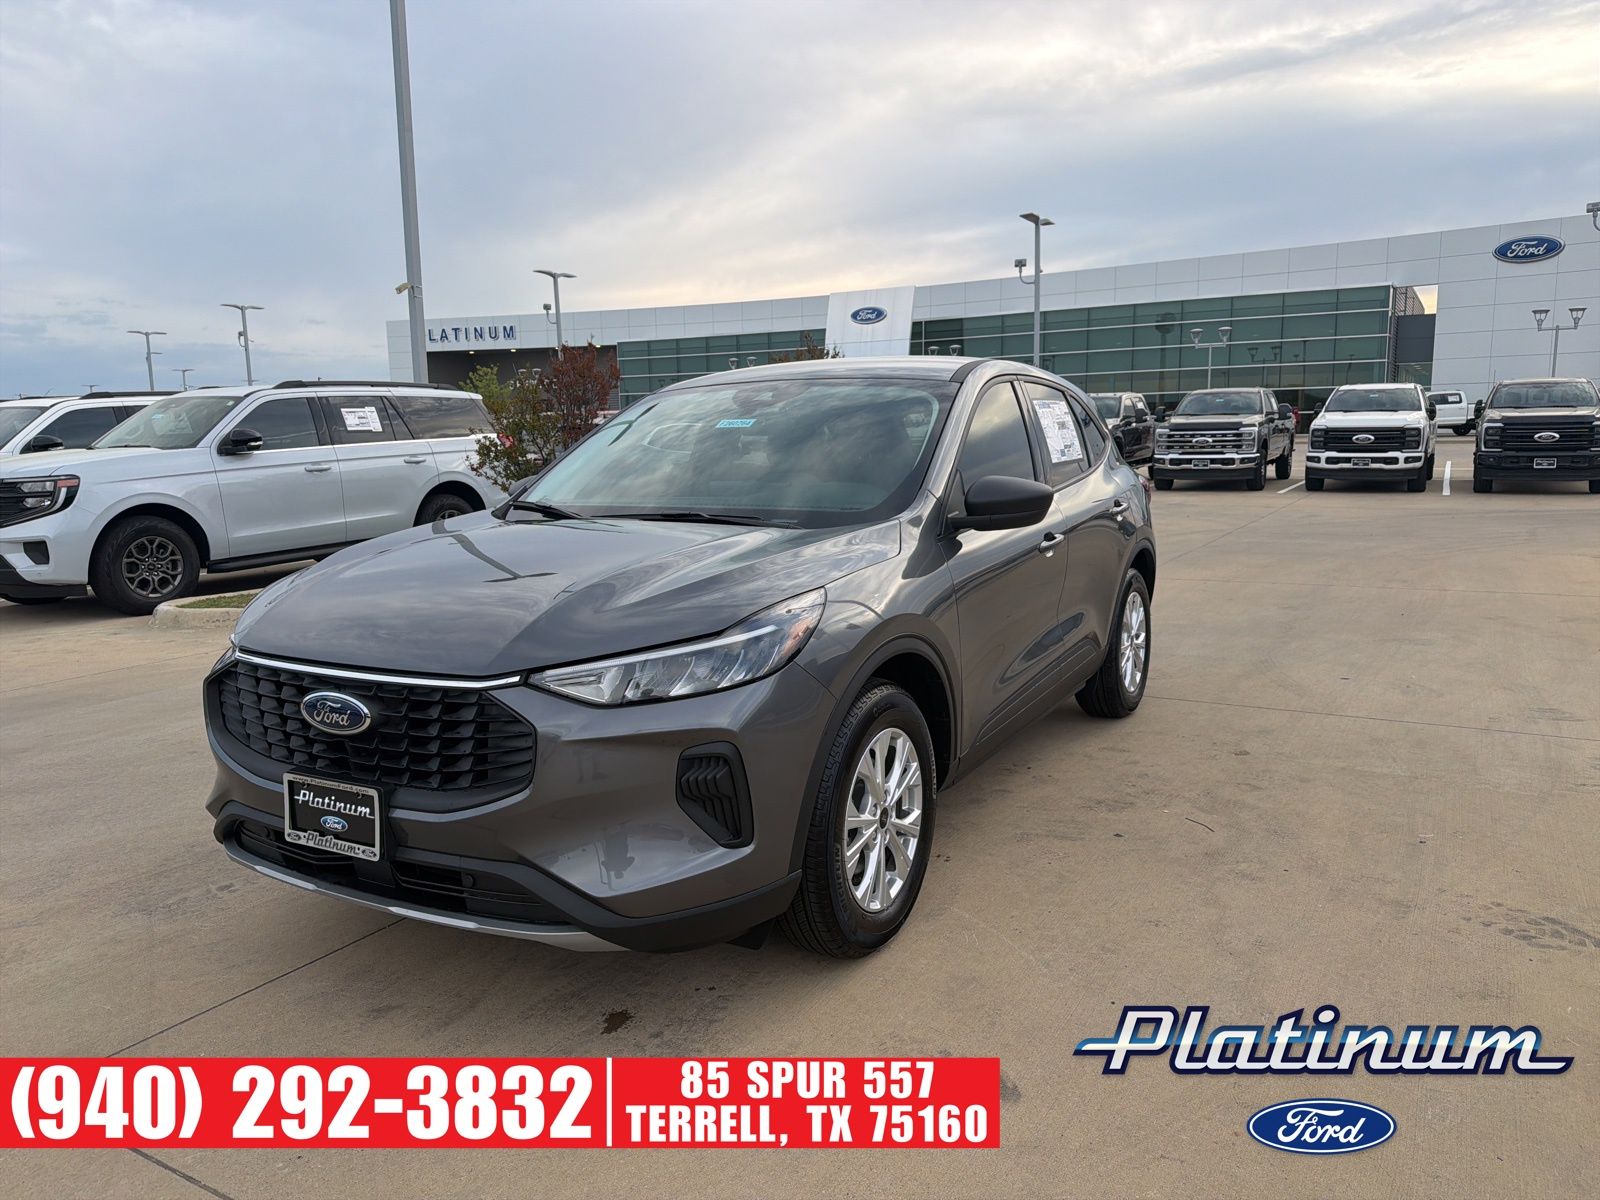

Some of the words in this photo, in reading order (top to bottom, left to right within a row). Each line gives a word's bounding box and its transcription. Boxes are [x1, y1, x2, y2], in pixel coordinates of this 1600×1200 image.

[1507, 241, 1548, 258] Ford
[856, 309, 878, 320] Ford
[428, 325, 516, 342] LATINUM
[313, 700, 351, 726] Ford
[293, 789, 375, 819] Platinum
[325, 816, 343, 830] Ford
[306, 830, 361, 856] Platinum
